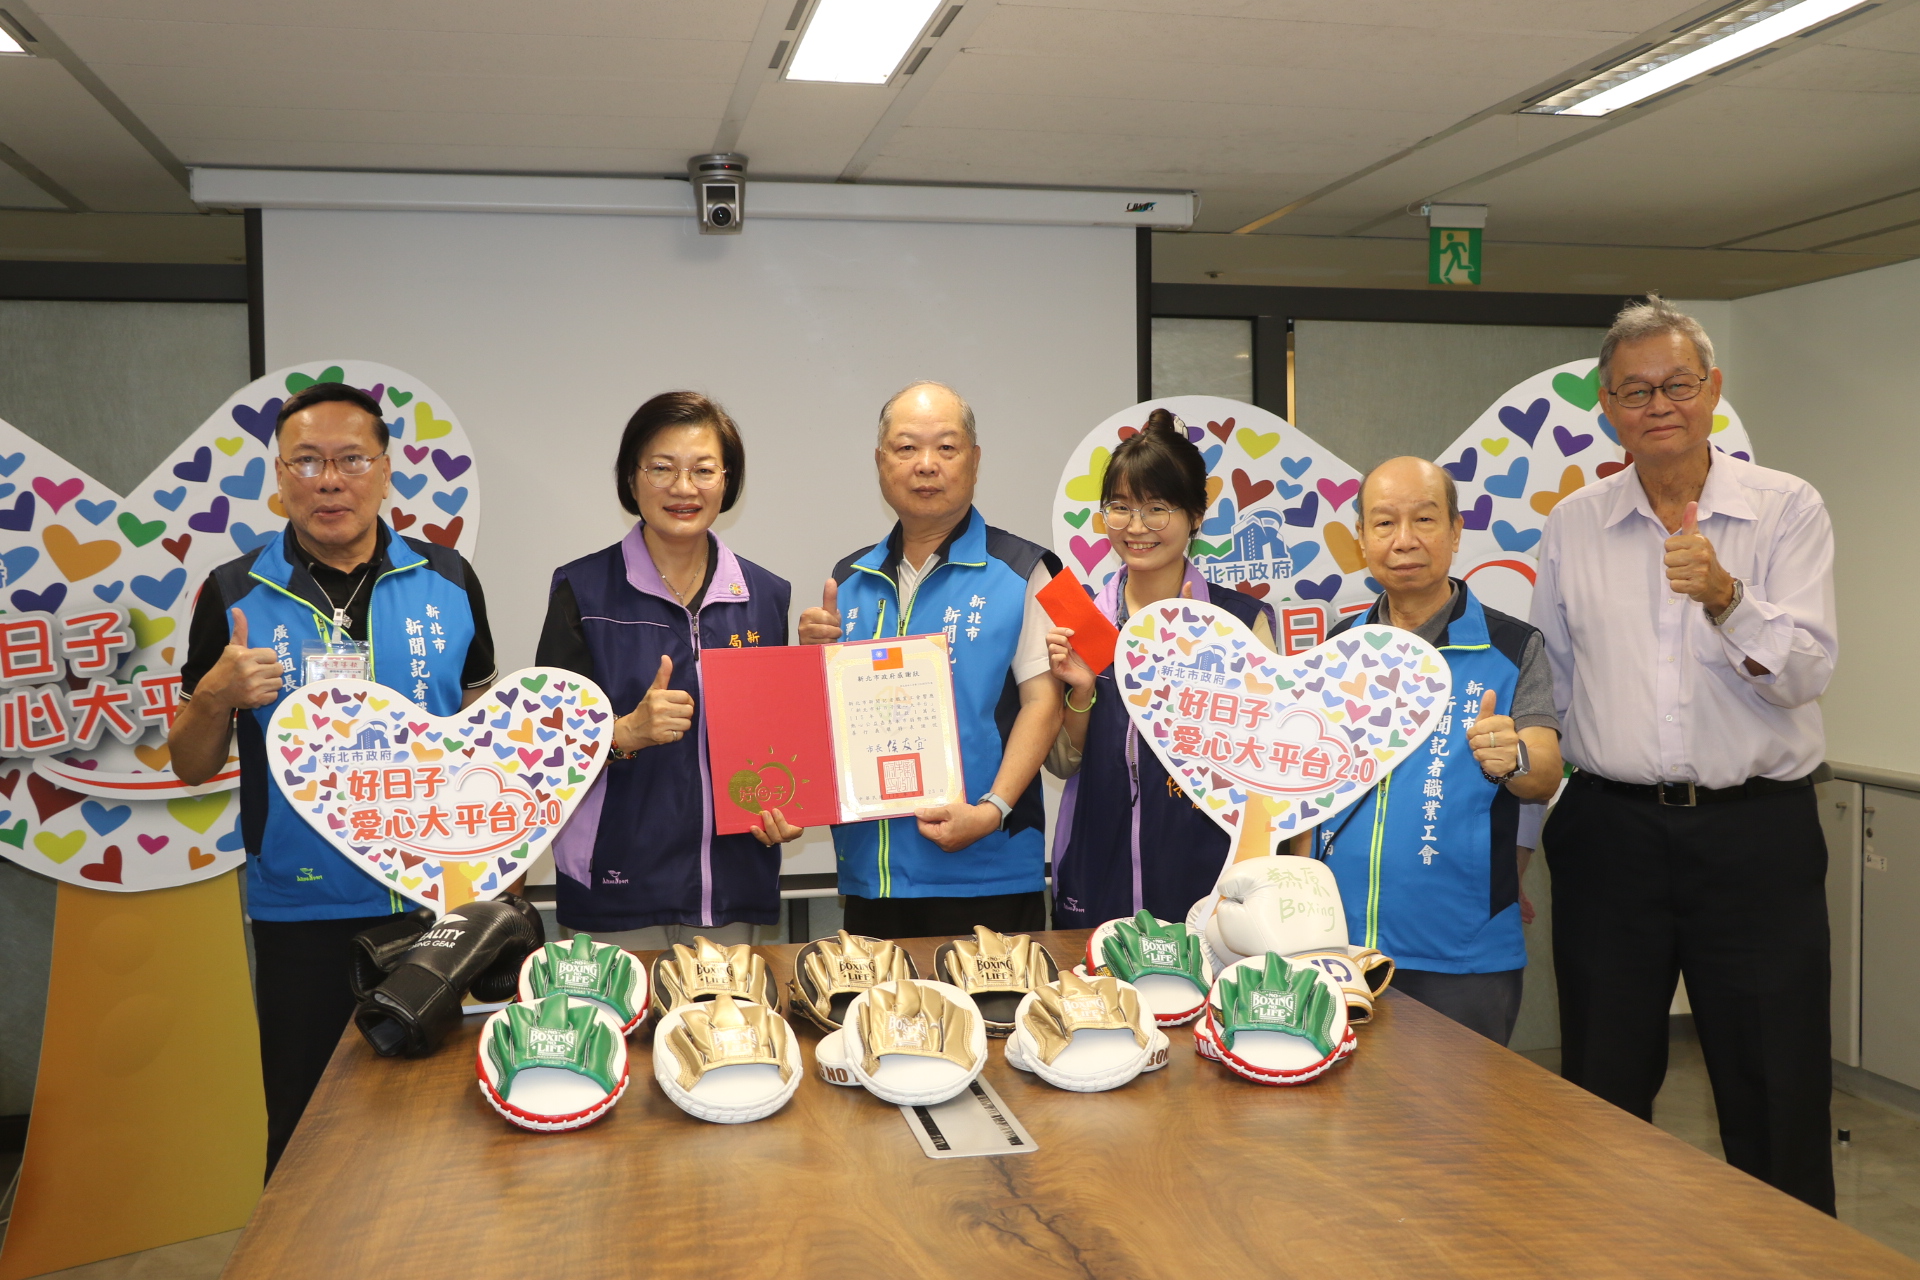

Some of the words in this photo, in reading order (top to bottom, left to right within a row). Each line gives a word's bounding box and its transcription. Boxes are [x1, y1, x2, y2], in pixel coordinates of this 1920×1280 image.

[1195, 560, 1291, 583] 北市政府
[846, 607, 859, 642] 理事
[965, 594, 987, 641] 新北市
[425, 603, 447, 654] 新北市
[272, 624, 300, 692] 廣宣組長
[1161, 665, 1225, 686] 新北市政府
[1178, 686, 1271, 729] 好日子
[322, 749, 392, 764] 新北市政府
[1171, 724, 1376, 784] 愛心大平台2.0
[347, 767, 446, 802] 好日子
[350, 799, 562, 843] 愛心大平台2.0
[1279, 897, 1336, 932] Boxing
[432, 940, 456, 949] GEAR
[1142, 938, 1178, 957] BOXING
[976, 958, 1014, 972] BOXING
[1151, 952, 1173, 962] LIFE
[559, 961, 598, 977] BOXING
[985, 971, 1009, 980] LIFE
[564, 973, 590, 984] LIFE
[1252, 993, 1295, 1010] BOXING
[1259, 1007, 1286, 1018] LIFE
[529, 1029, 575, 1046] BOXING
[537, 1043, 566, 1053] LIFE
[825, 1066, 849, 1083] NO
